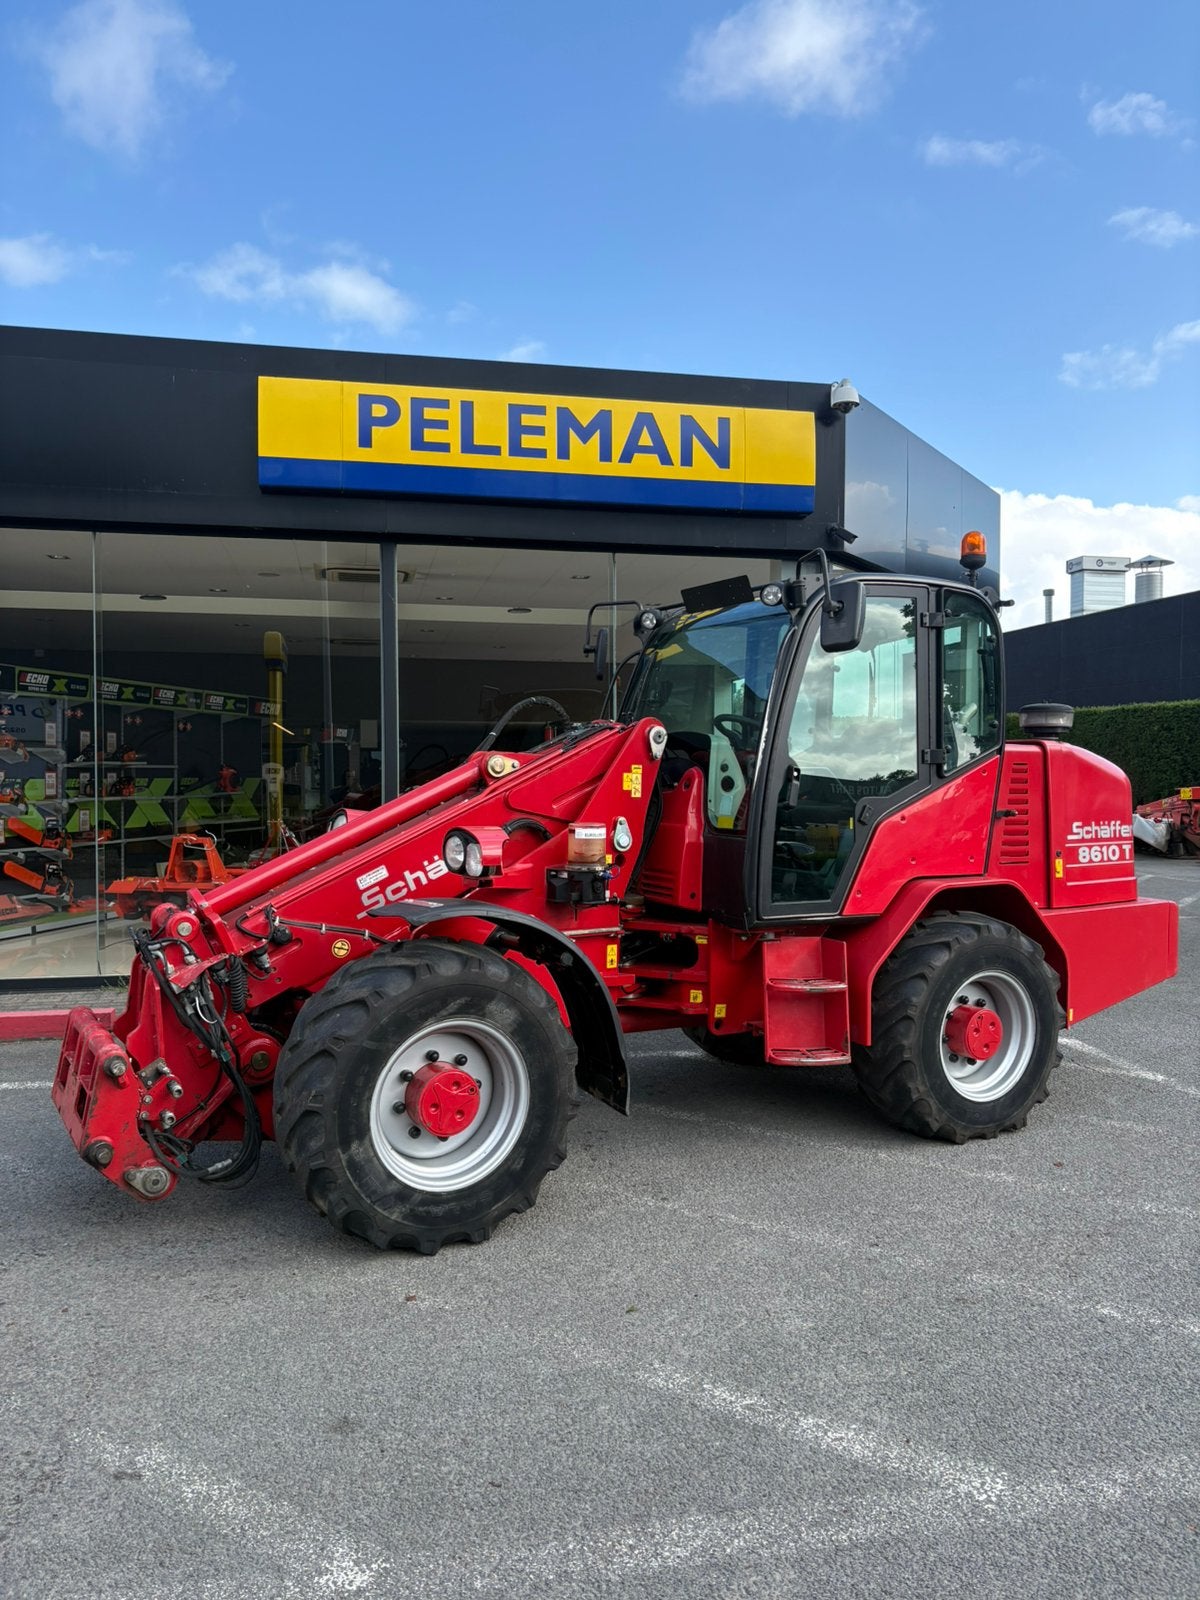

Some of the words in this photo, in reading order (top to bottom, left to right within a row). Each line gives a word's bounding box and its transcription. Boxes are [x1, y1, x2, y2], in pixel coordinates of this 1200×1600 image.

[358, 393, 730, 470] PELEMAN
[26, 673, 49, 684] ECHO
[101, 682, 119, 692] ECHO
[160, 689, 175, 699] ECHO
[209, 695, 224, 704] ECHO
[260, 702, 279, 715] ECHO
[1078, 845, 1120, 863] 8610
[1122, 844, 1131, 860] T
